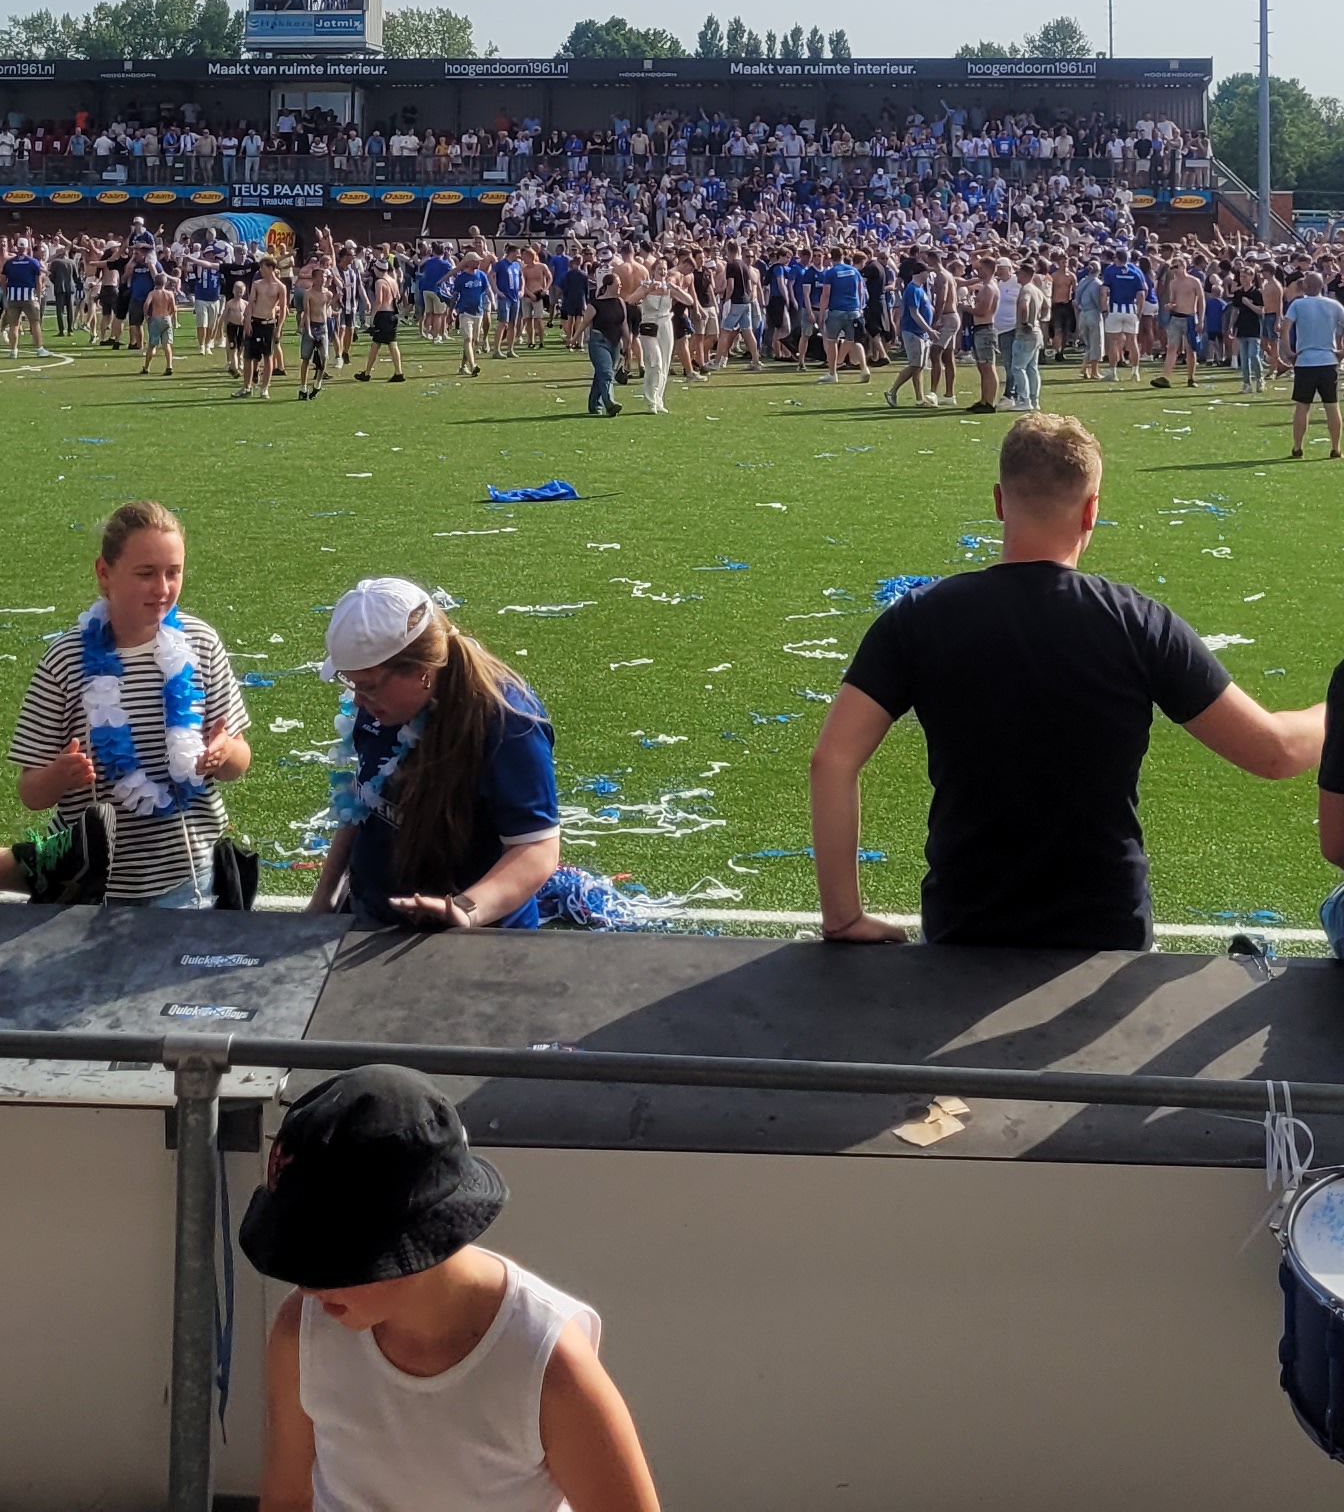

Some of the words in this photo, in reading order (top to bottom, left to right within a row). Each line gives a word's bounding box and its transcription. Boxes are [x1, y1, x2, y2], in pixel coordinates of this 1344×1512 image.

[208, 63, 250, 75] Maakt
[253, 66, 277, 75] van
[279, 63, 324, 75] ruimte
[327, 63, 388, 75] interieur.
[445, 62, 569, 76] hoogendoorn1961.nl
[730, 62, 774, 75] Maakt
[777, 65, 802, 75] van
[804, 62, 851, 75] ruimte
[854, 62, 917, 75] interieur.
[967, 61, 1097, 76] hoogendoorn1961.nl
[233, 184, 269, 196] TEUS
[273, 184, 323, 196] PAANS
[262, 198, 294, 206] TRIBUNE
[180, 954, 211, 965] Quick
[168, 1004, 200, 1016] Quick
